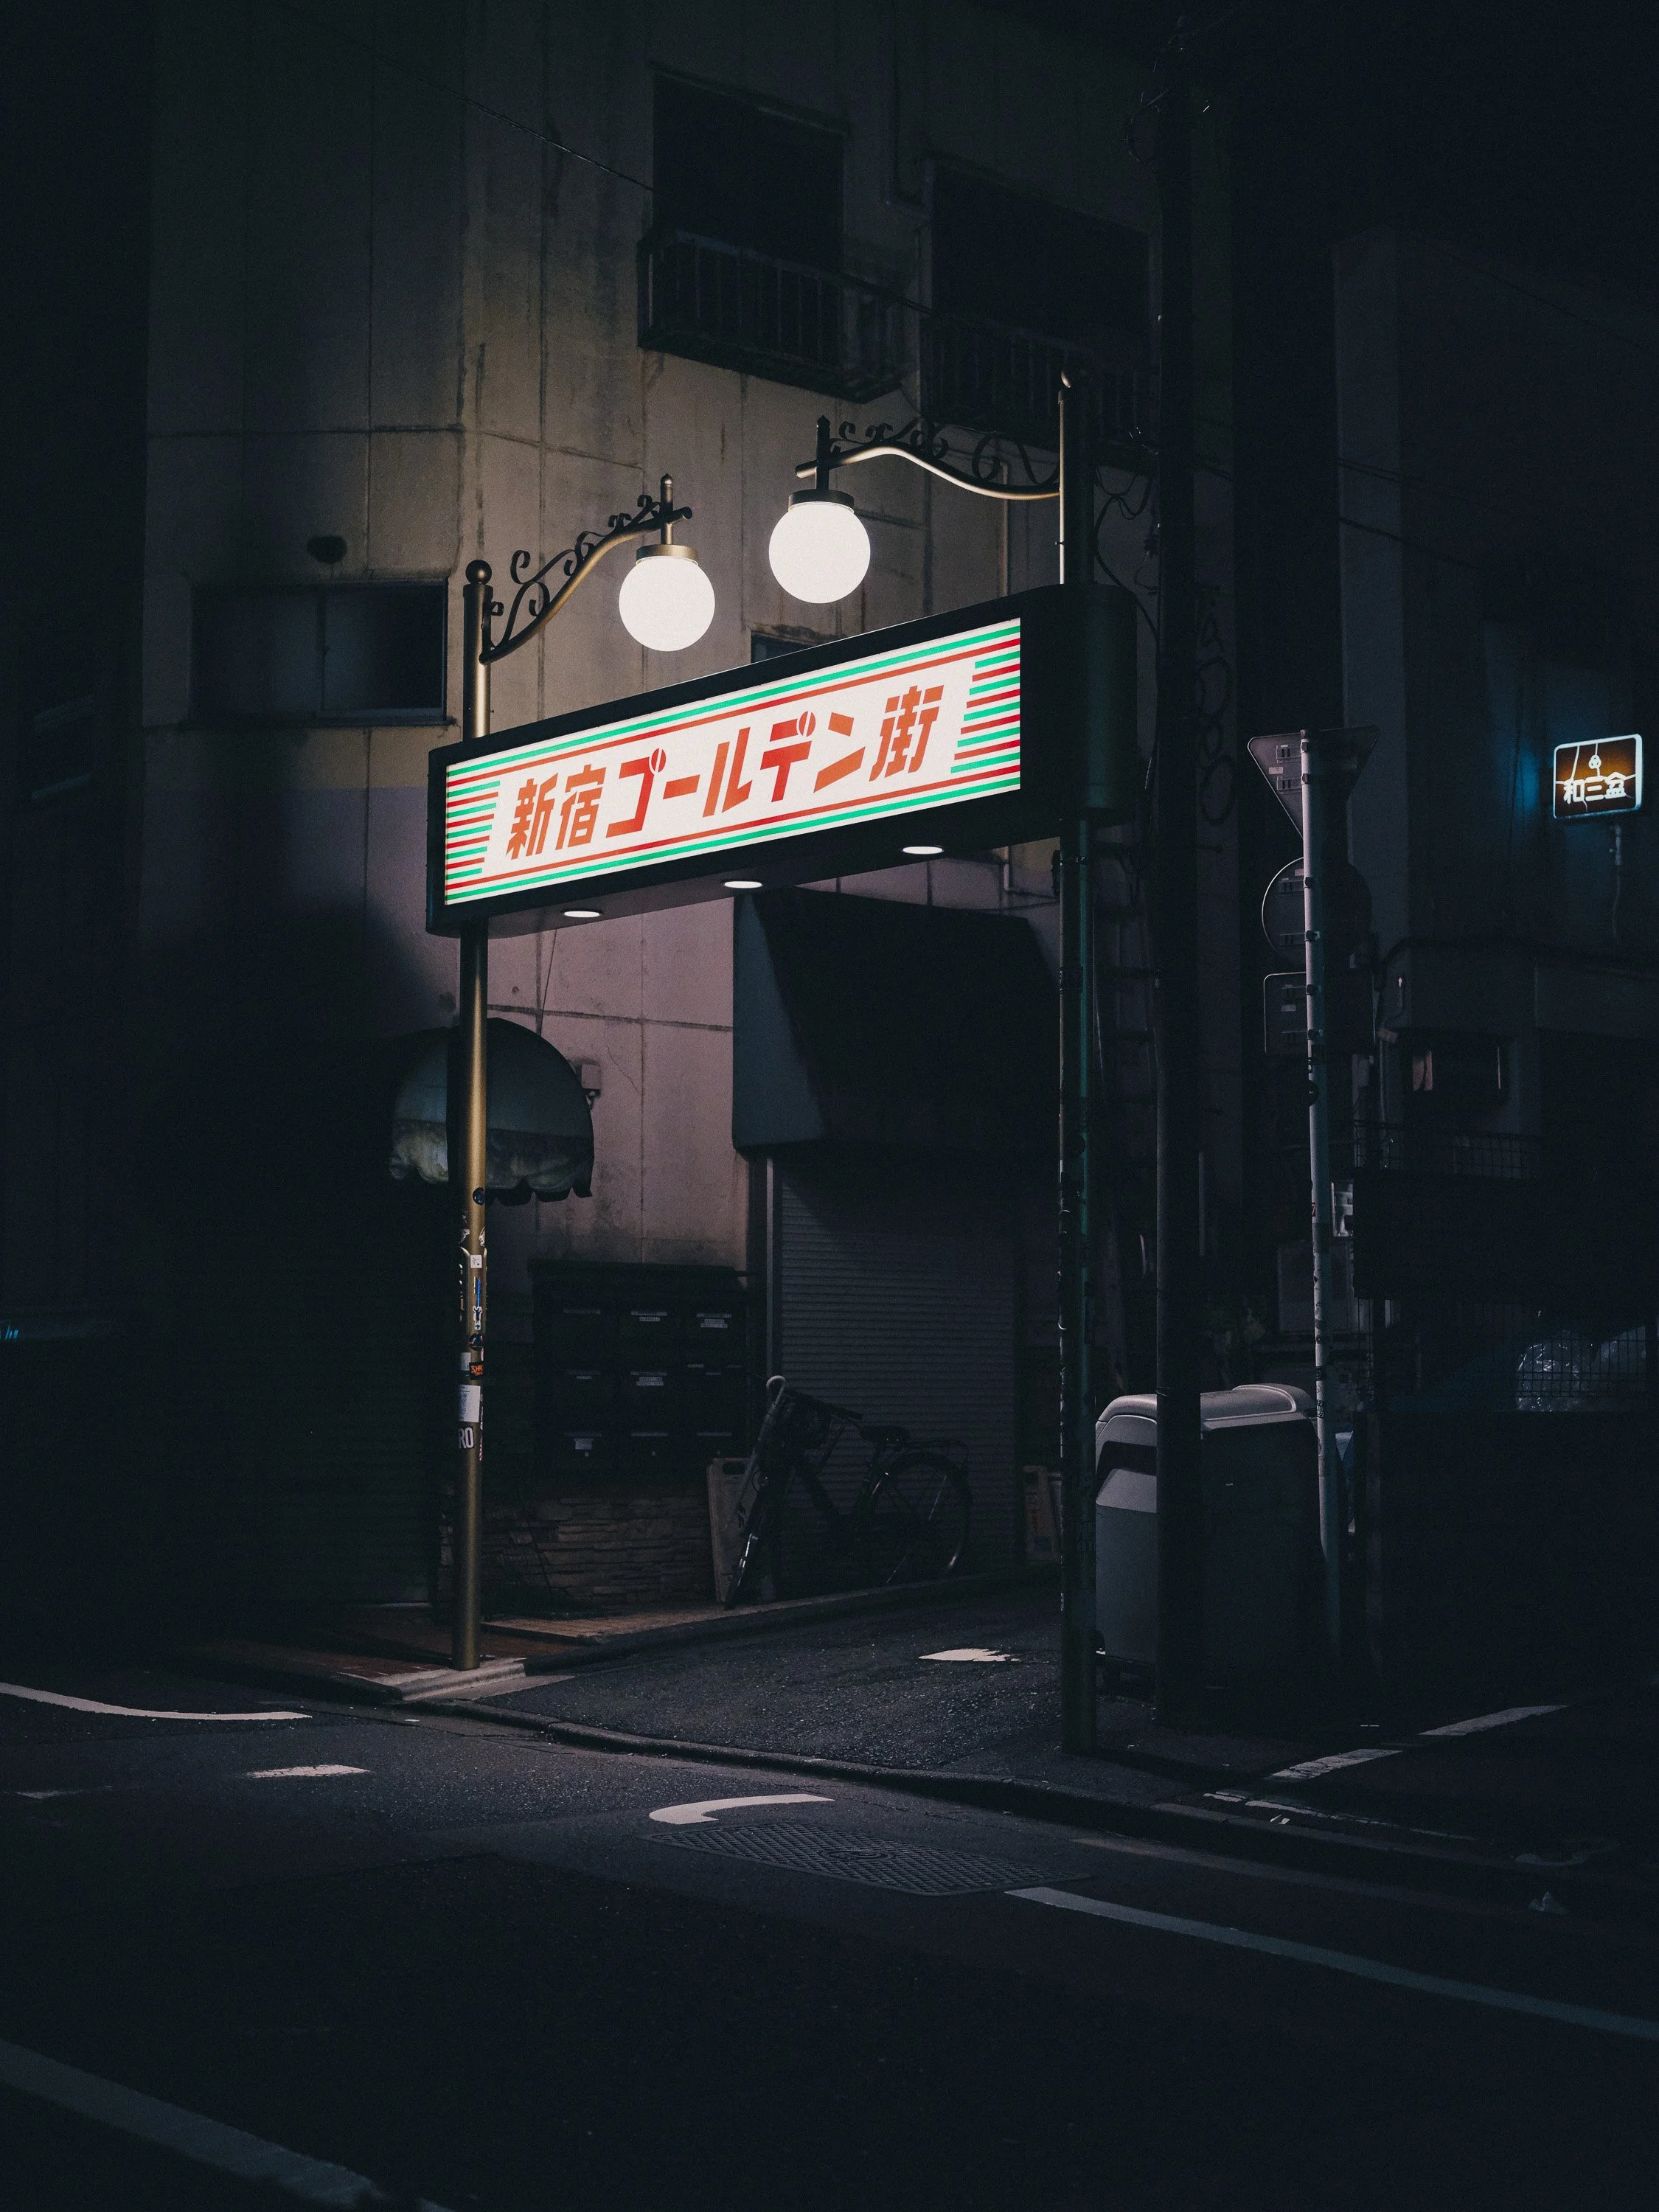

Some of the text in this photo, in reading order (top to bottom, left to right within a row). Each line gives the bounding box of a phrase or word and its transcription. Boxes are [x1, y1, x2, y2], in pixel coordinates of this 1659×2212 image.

[505, 684, 945, 860] 新宿ゴールデン街
[1563, 771, 1627, 804] 和三盆
